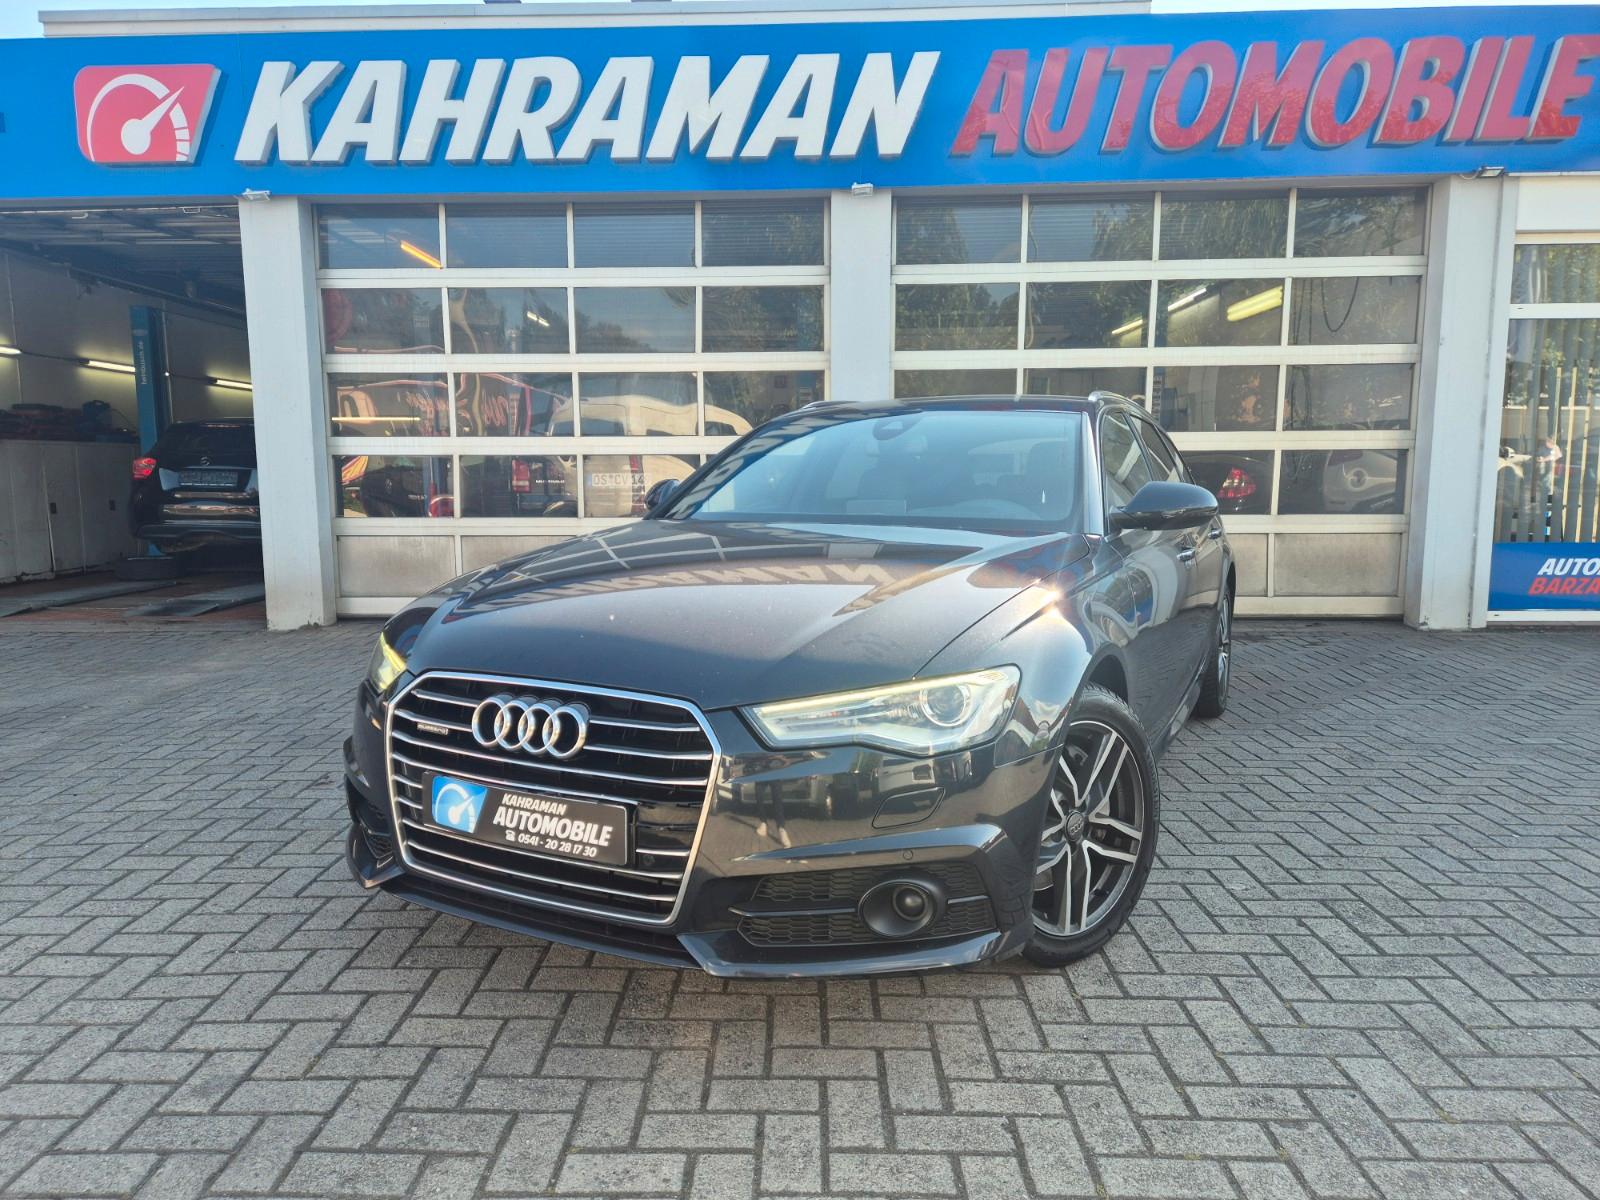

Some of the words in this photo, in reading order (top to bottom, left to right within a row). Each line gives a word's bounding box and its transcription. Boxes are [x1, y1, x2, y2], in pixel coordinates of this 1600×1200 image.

[234, 50, 940, 164] KAHRAMAN
[950, 34, 1600, 157] AUTOMOBILE
[1537, 557, 1600, 576] AUTO
[502, 793, 567, 816] KAHRAMAN
[493, 806, 613, 846] AUTOMOBILE
[518, 833, 539, 846] 0541
[545, 838, 558, 850] 20
[559, 841, 571, 852] 28
[573, 844, 583, 854] 17
[583, 846, 597, 857] 30
